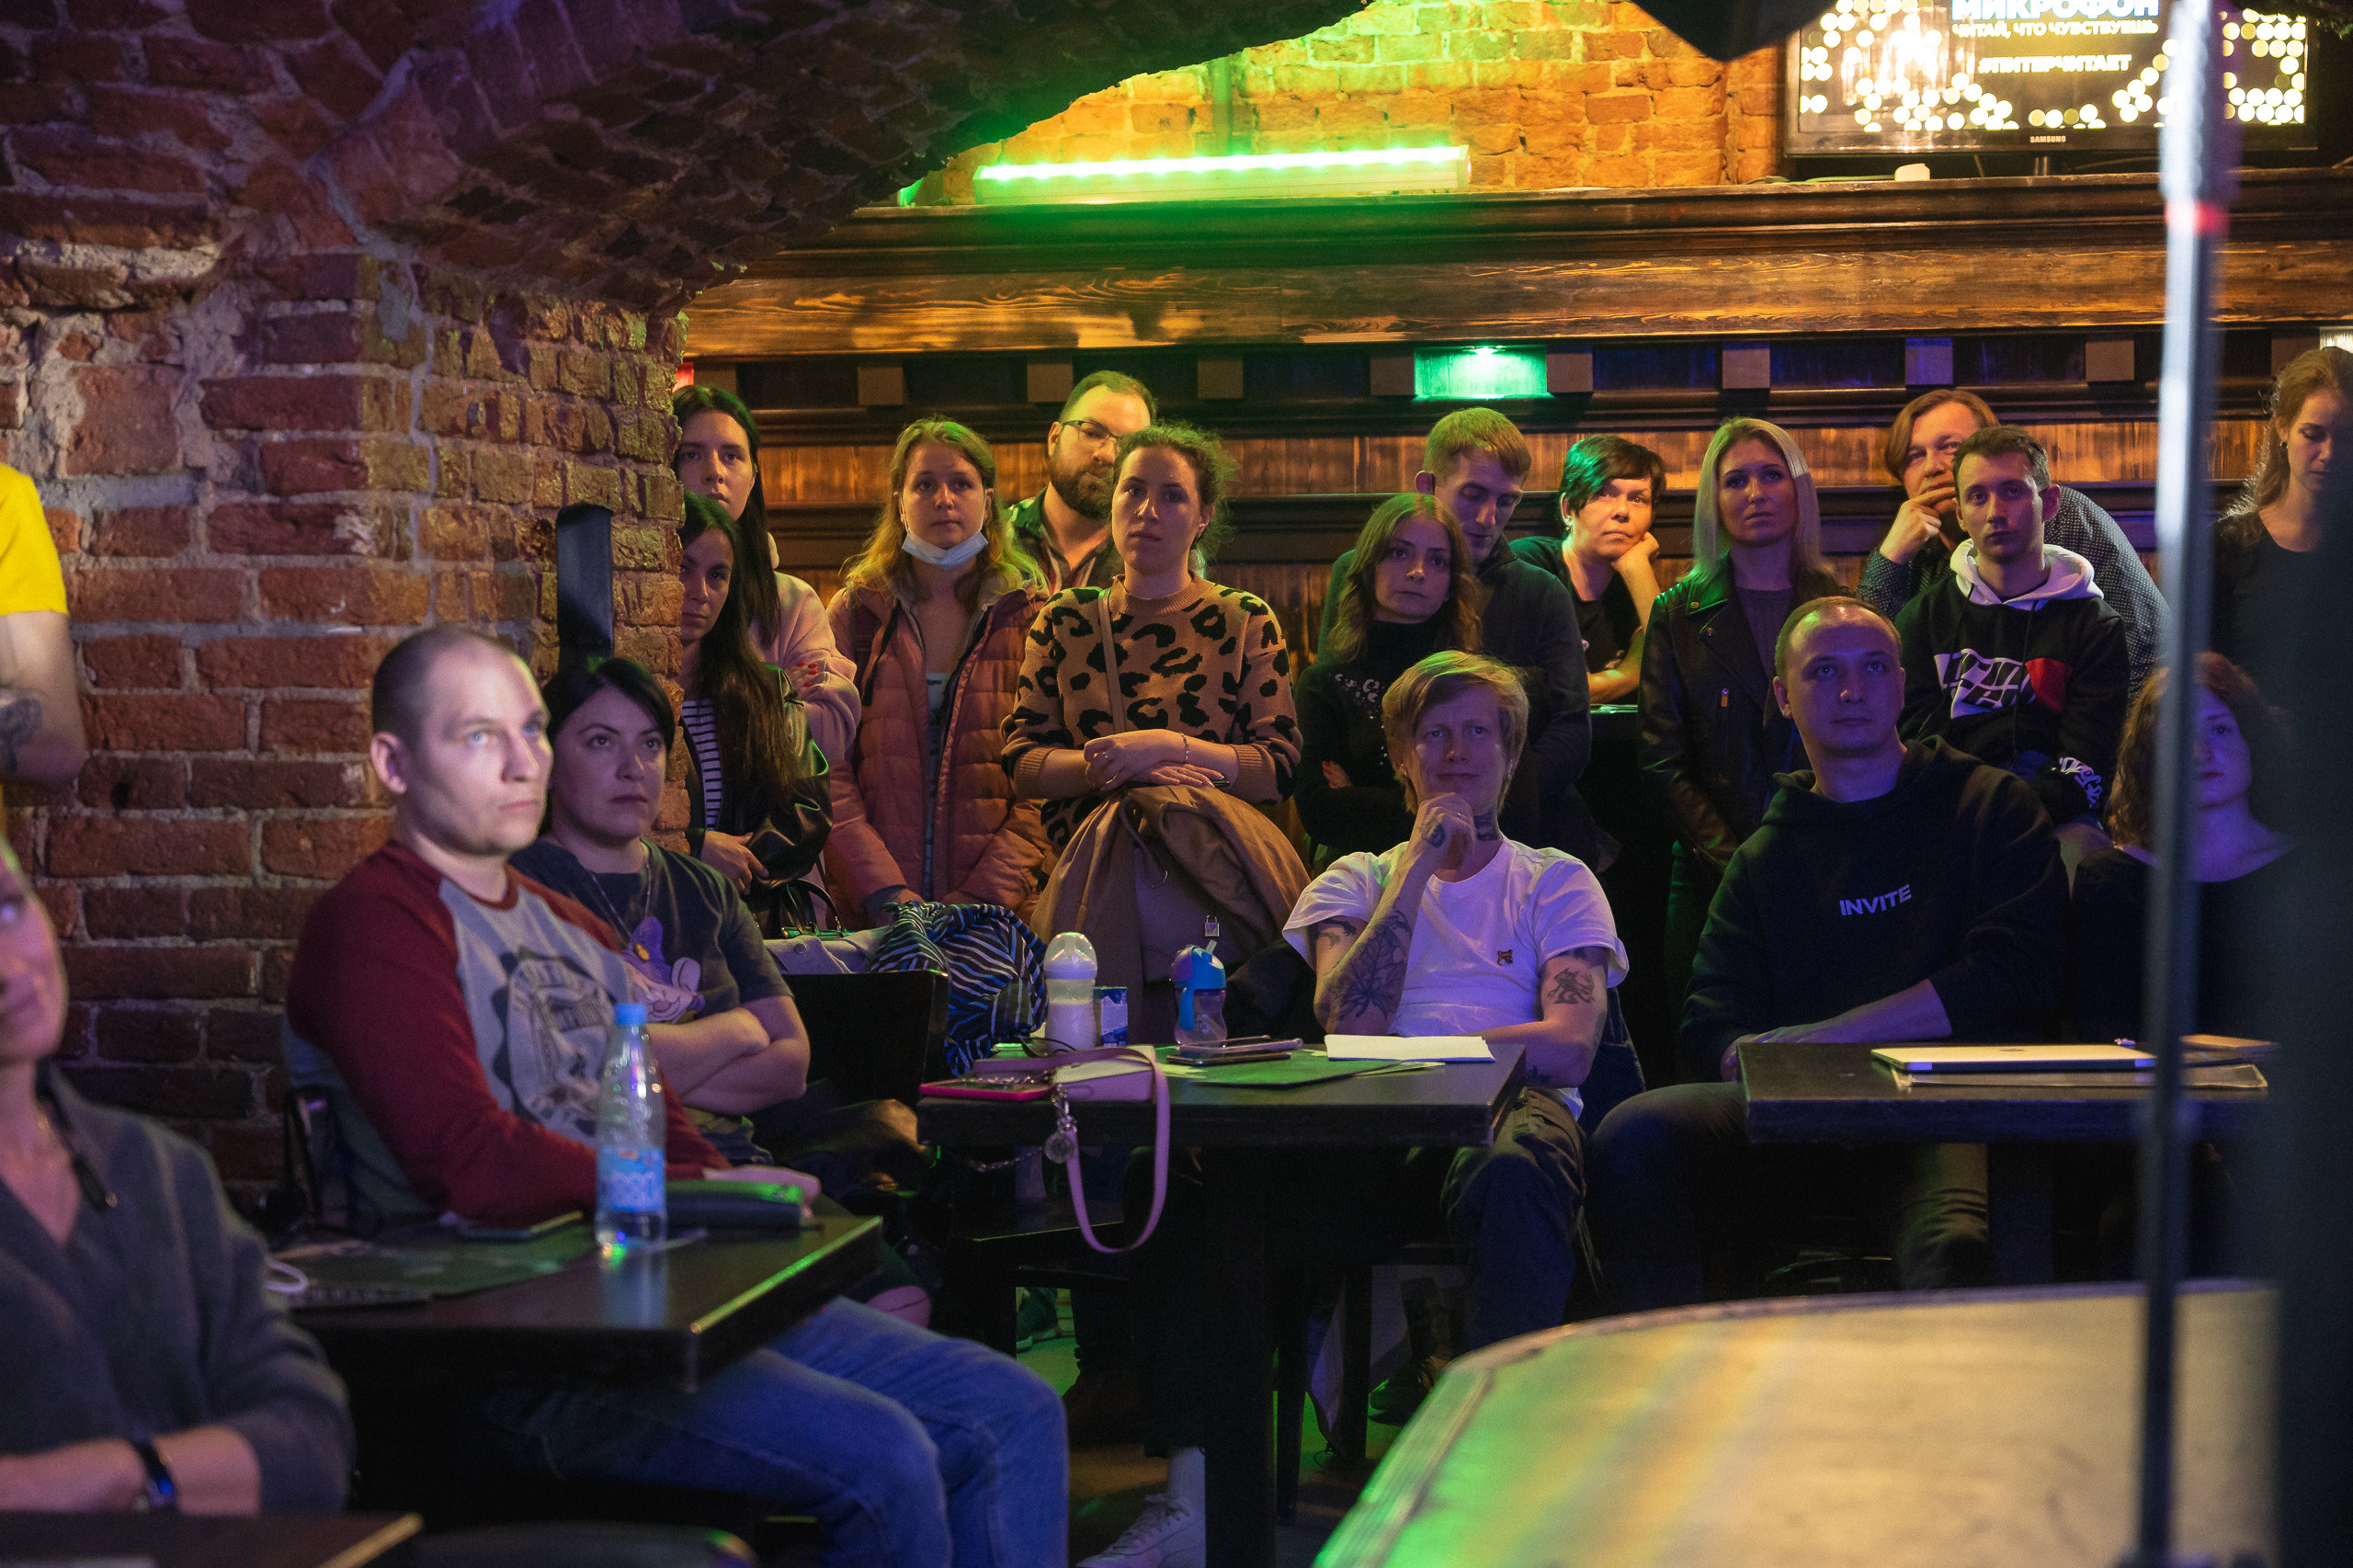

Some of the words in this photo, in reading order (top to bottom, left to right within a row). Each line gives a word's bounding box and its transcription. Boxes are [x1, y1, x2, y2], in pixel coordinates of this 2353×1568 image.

[1951, 0, 2159, 20] МИКРОФОН
[1952, 20, 2011, 39] ЧИТАЙ,
[2013, 22, 2048, 37] ЧТО
[2049, 20, 2158, 36] ЧУВСТВУЕШЬ
[1978, 54, 2131, 74] #ПИТЕРЧИТАЕТ
[2029, 135, 2066, 143] SAMSUNG
[1839, 883, 1912, 916] INVITE
